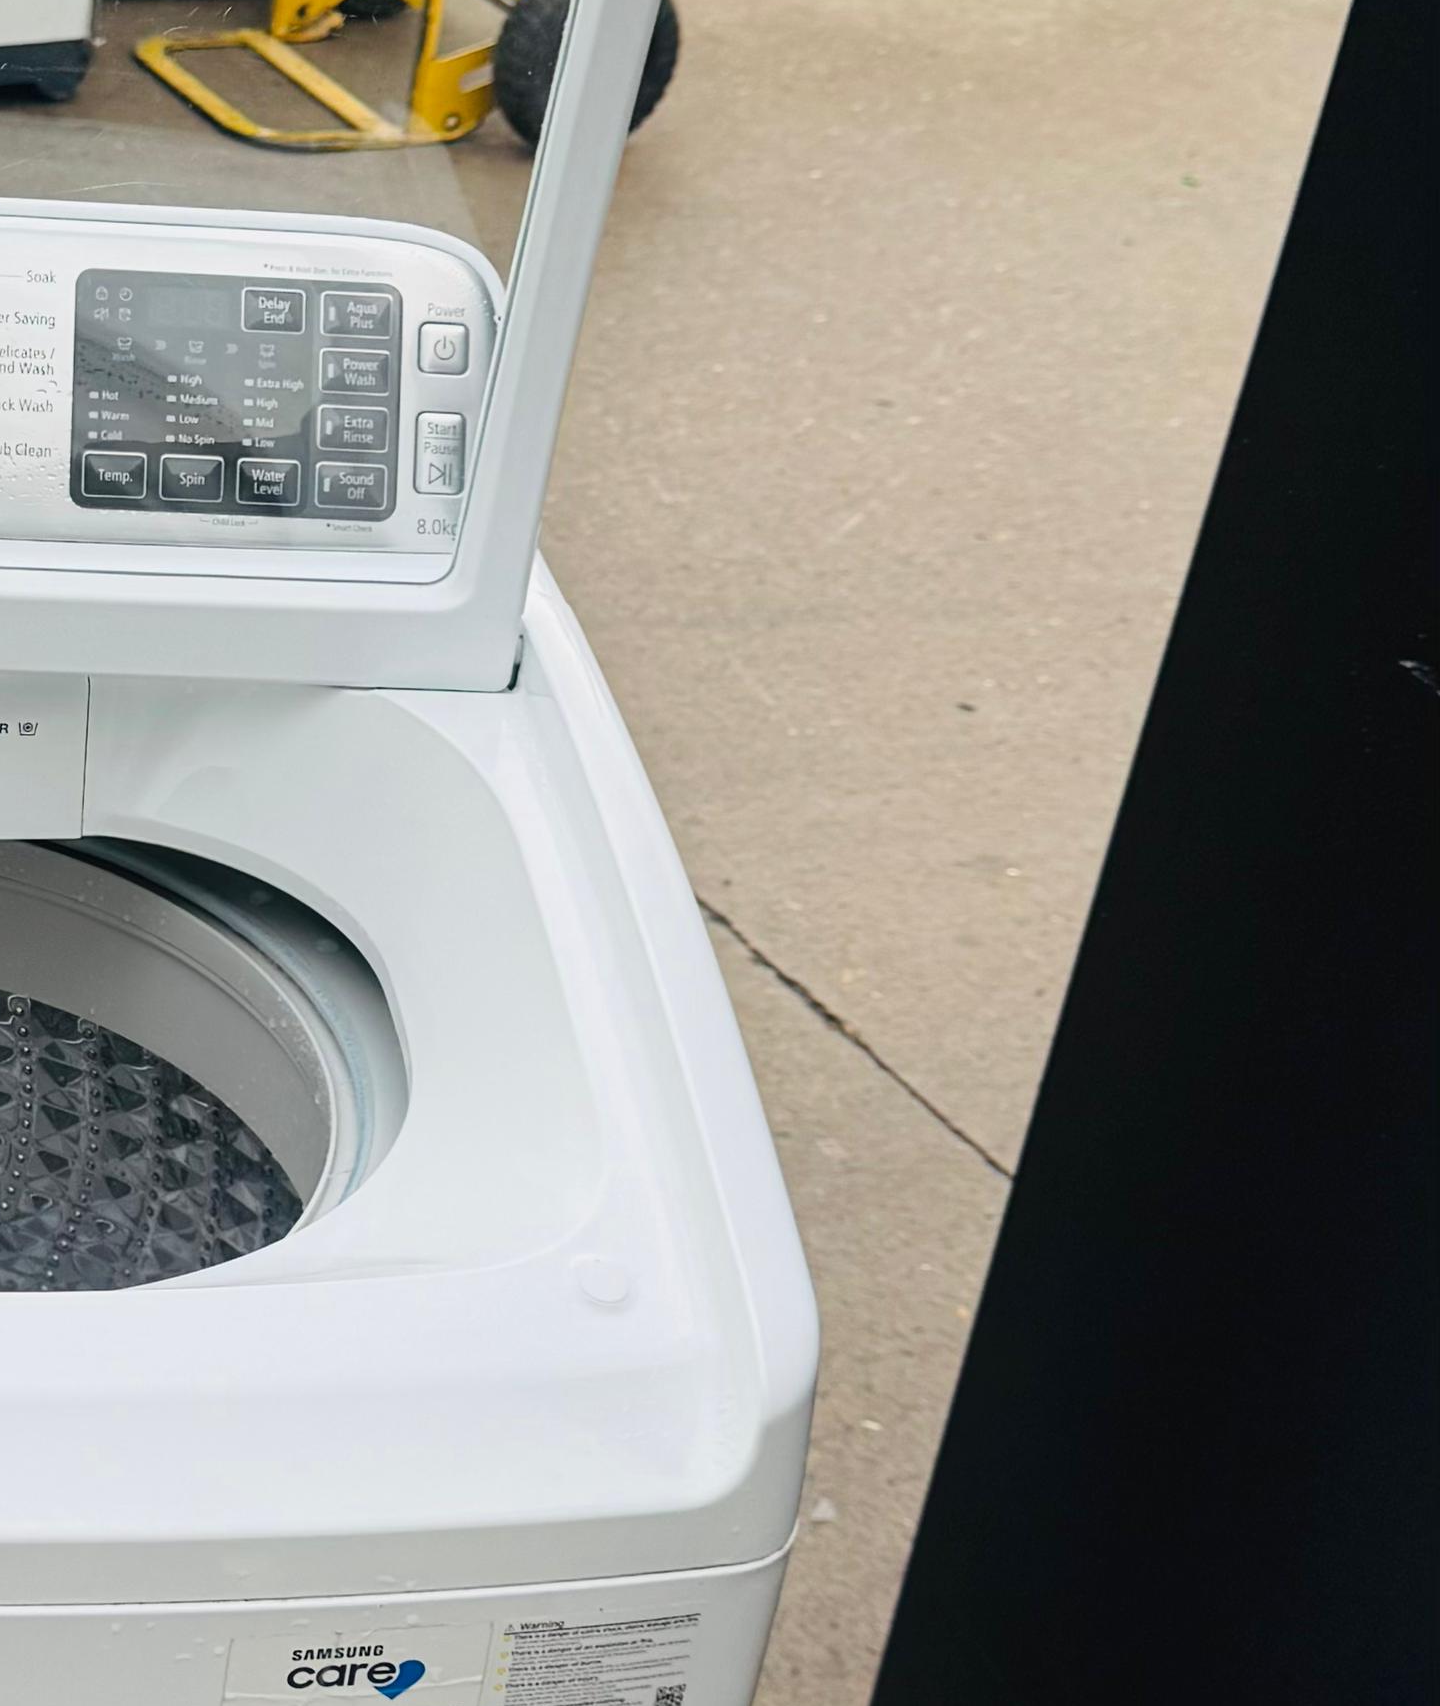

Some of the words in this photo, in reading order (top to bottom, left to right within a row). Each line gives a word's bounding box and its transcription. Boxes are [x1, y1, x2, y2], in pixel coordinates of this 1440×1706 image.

[26, 270, 56, 284] Soak
[258, 296, 291, 312] Delay
[347, 302, 378, 318] Aqua
[427, 303, 467, 318] Power
[14, 311, 56, 329] Saving
[264, 312, 285, 325] End
[350, 316, 374, 330] Plus
[19, 362, 54, 376] Wash
[343, 358, 378, 372] Power
[180, 374, 203, 388] High
[256, 379, 280, 390] Extra
[282, 379, 304, 393] High
[344, 372, 376, 386] Wash
[102, 390, 119, 401] Hot
[180, 394, 219, 406] Medium
[19, 399, 53, 413] Wash
[256, 398, 278, 411] High
[101, 411, 130, 421] Warm
[179, 414, 200, 425] Low
[255, 417, 275, 429] Mid
[344, 415, 374, 429] Extra
[100, 430, 123, 441] Cold
[427, 422, 458, 436] Start
[178, 434, 193, 444] No
[194, 435, 216, 448] Spin
[254, 438, 276, 449] Low
[343, 430, 374, 444] Rinse
[15, 443, 52, 458] Clean
[424, 441, 460, 455] Pause
[98, 468, 134, 484] Temp.
[179, 472, 206, 487] Spin
[252, 468, 286, 482] Water
[339, 472, 375, 486] Sound
[254, 482, 284, 495] Level
[347, 487, 366, 499] Off
[520, 1620, 564, 1631] Warning
[292, 1645, 384, 1661] SAMSUNG
[287, 1662, 396, 1688] care
